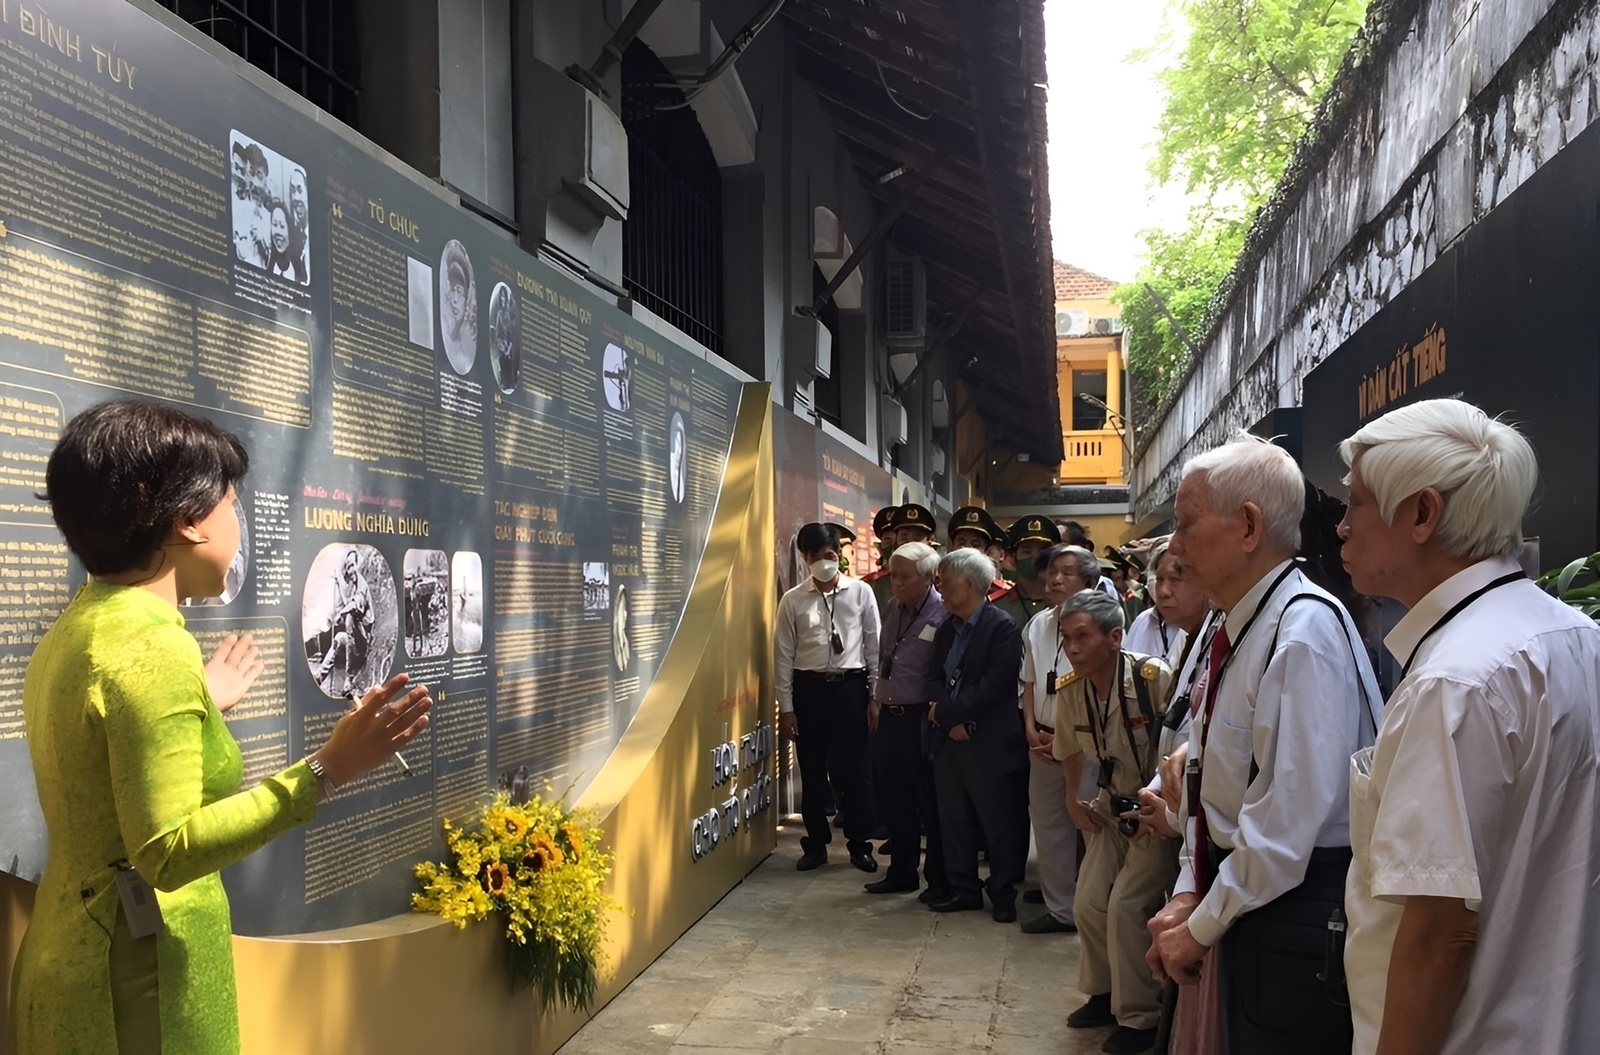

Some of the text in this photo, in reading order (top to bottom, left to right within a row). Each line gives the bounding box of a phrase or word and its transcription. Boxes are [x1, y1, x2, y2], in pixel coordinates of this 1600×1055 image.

[19, 1, 82, 63] ĐÌNH
[90, 40, 138, 90] TÚY
[1389, 342, 1410, 402] CẤT
[1412, 321, 1446, 388] TIẾNG
